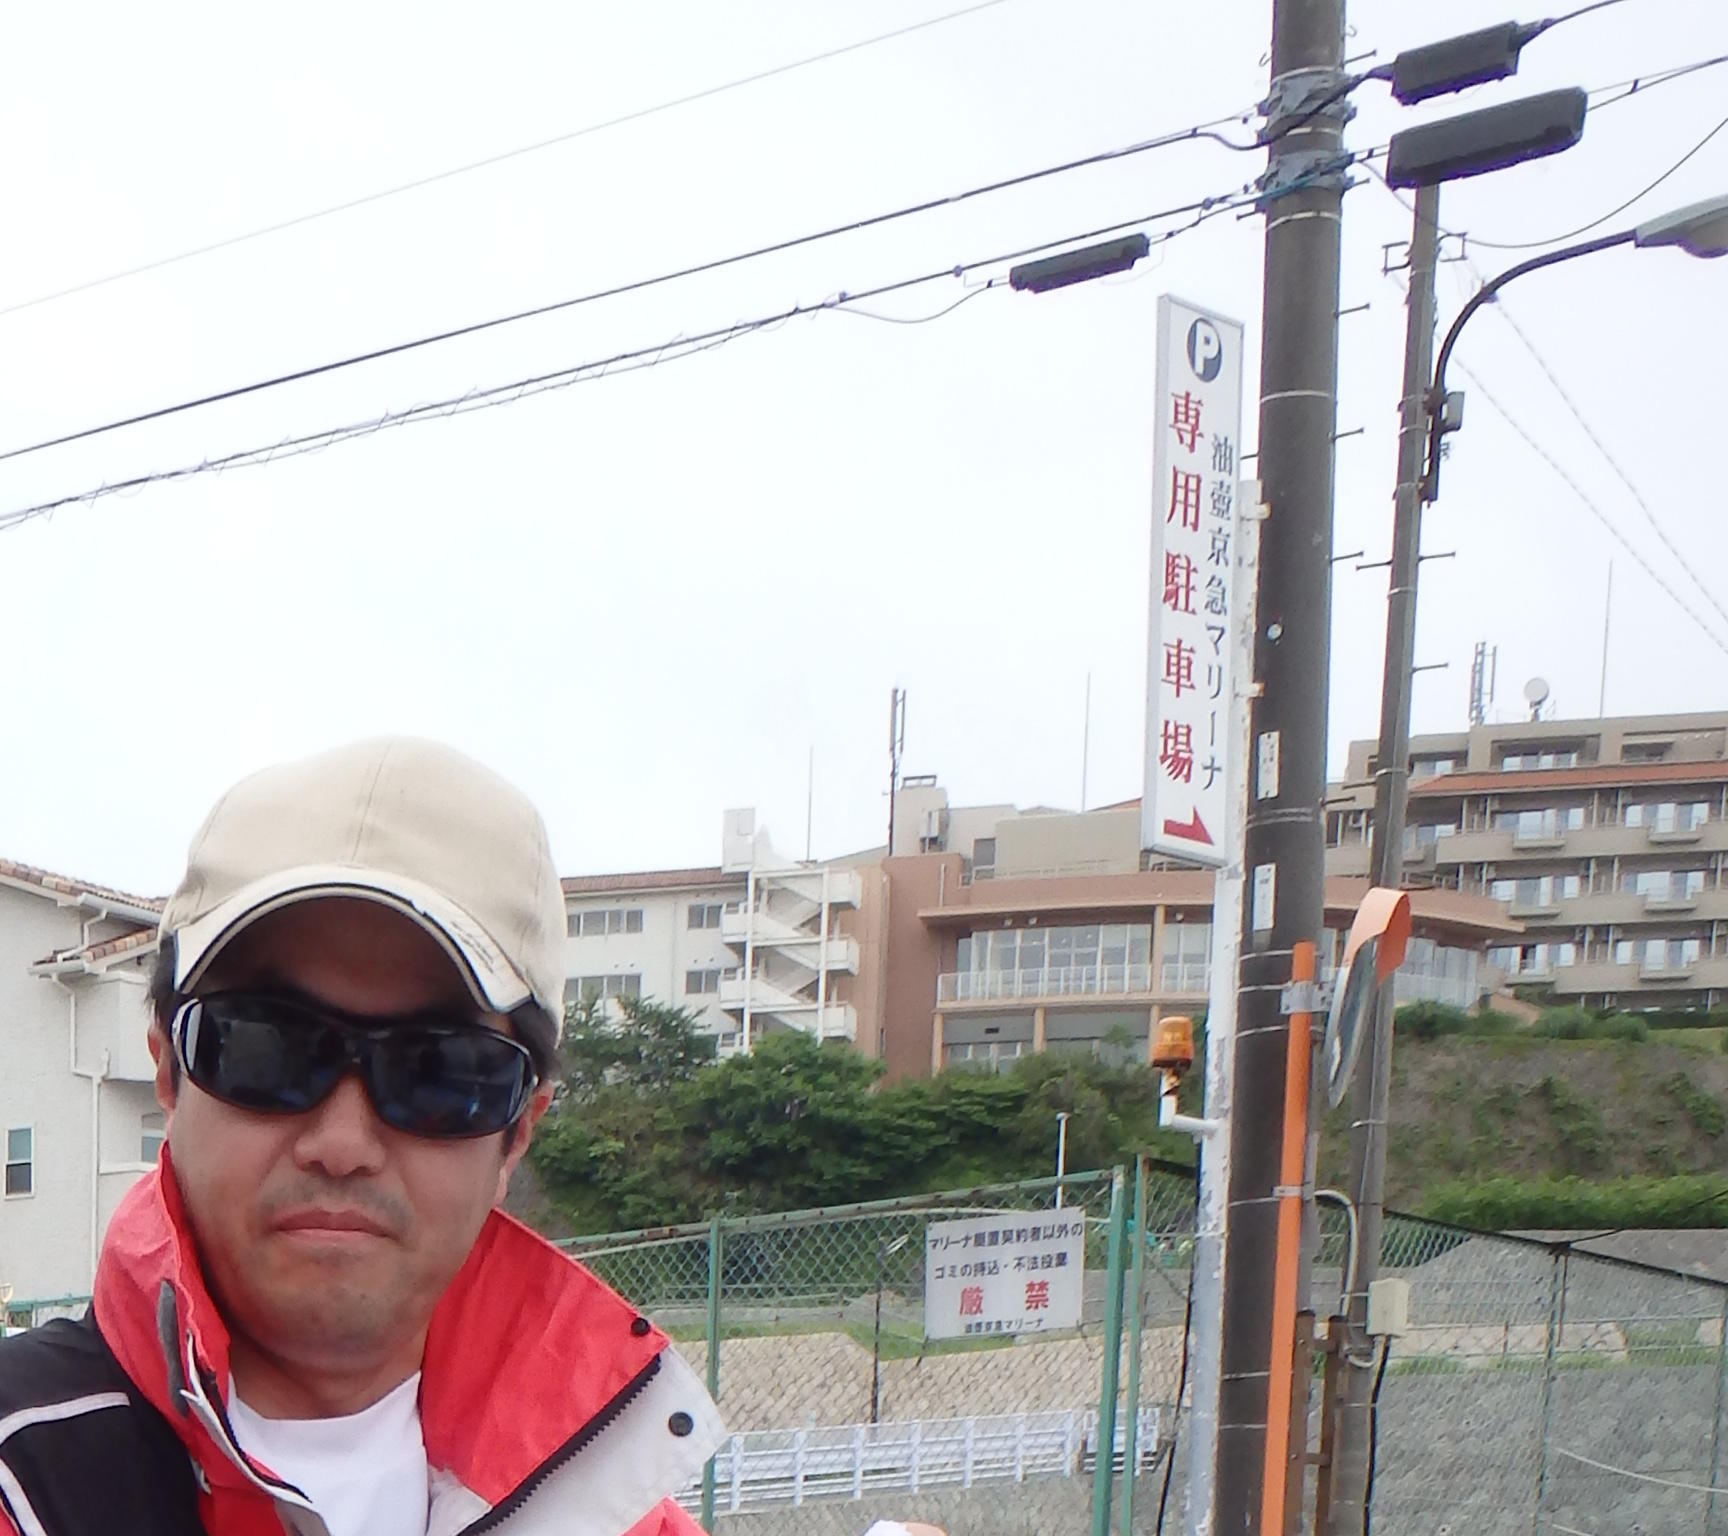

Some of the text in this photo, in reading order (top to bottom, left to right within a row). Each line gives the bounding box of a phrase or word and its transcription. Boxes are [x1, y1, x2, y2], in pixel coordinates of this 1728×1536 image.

[1194, 320, 1220, 377] P
[1160, 390, 1204, 784] 専用駐車場
